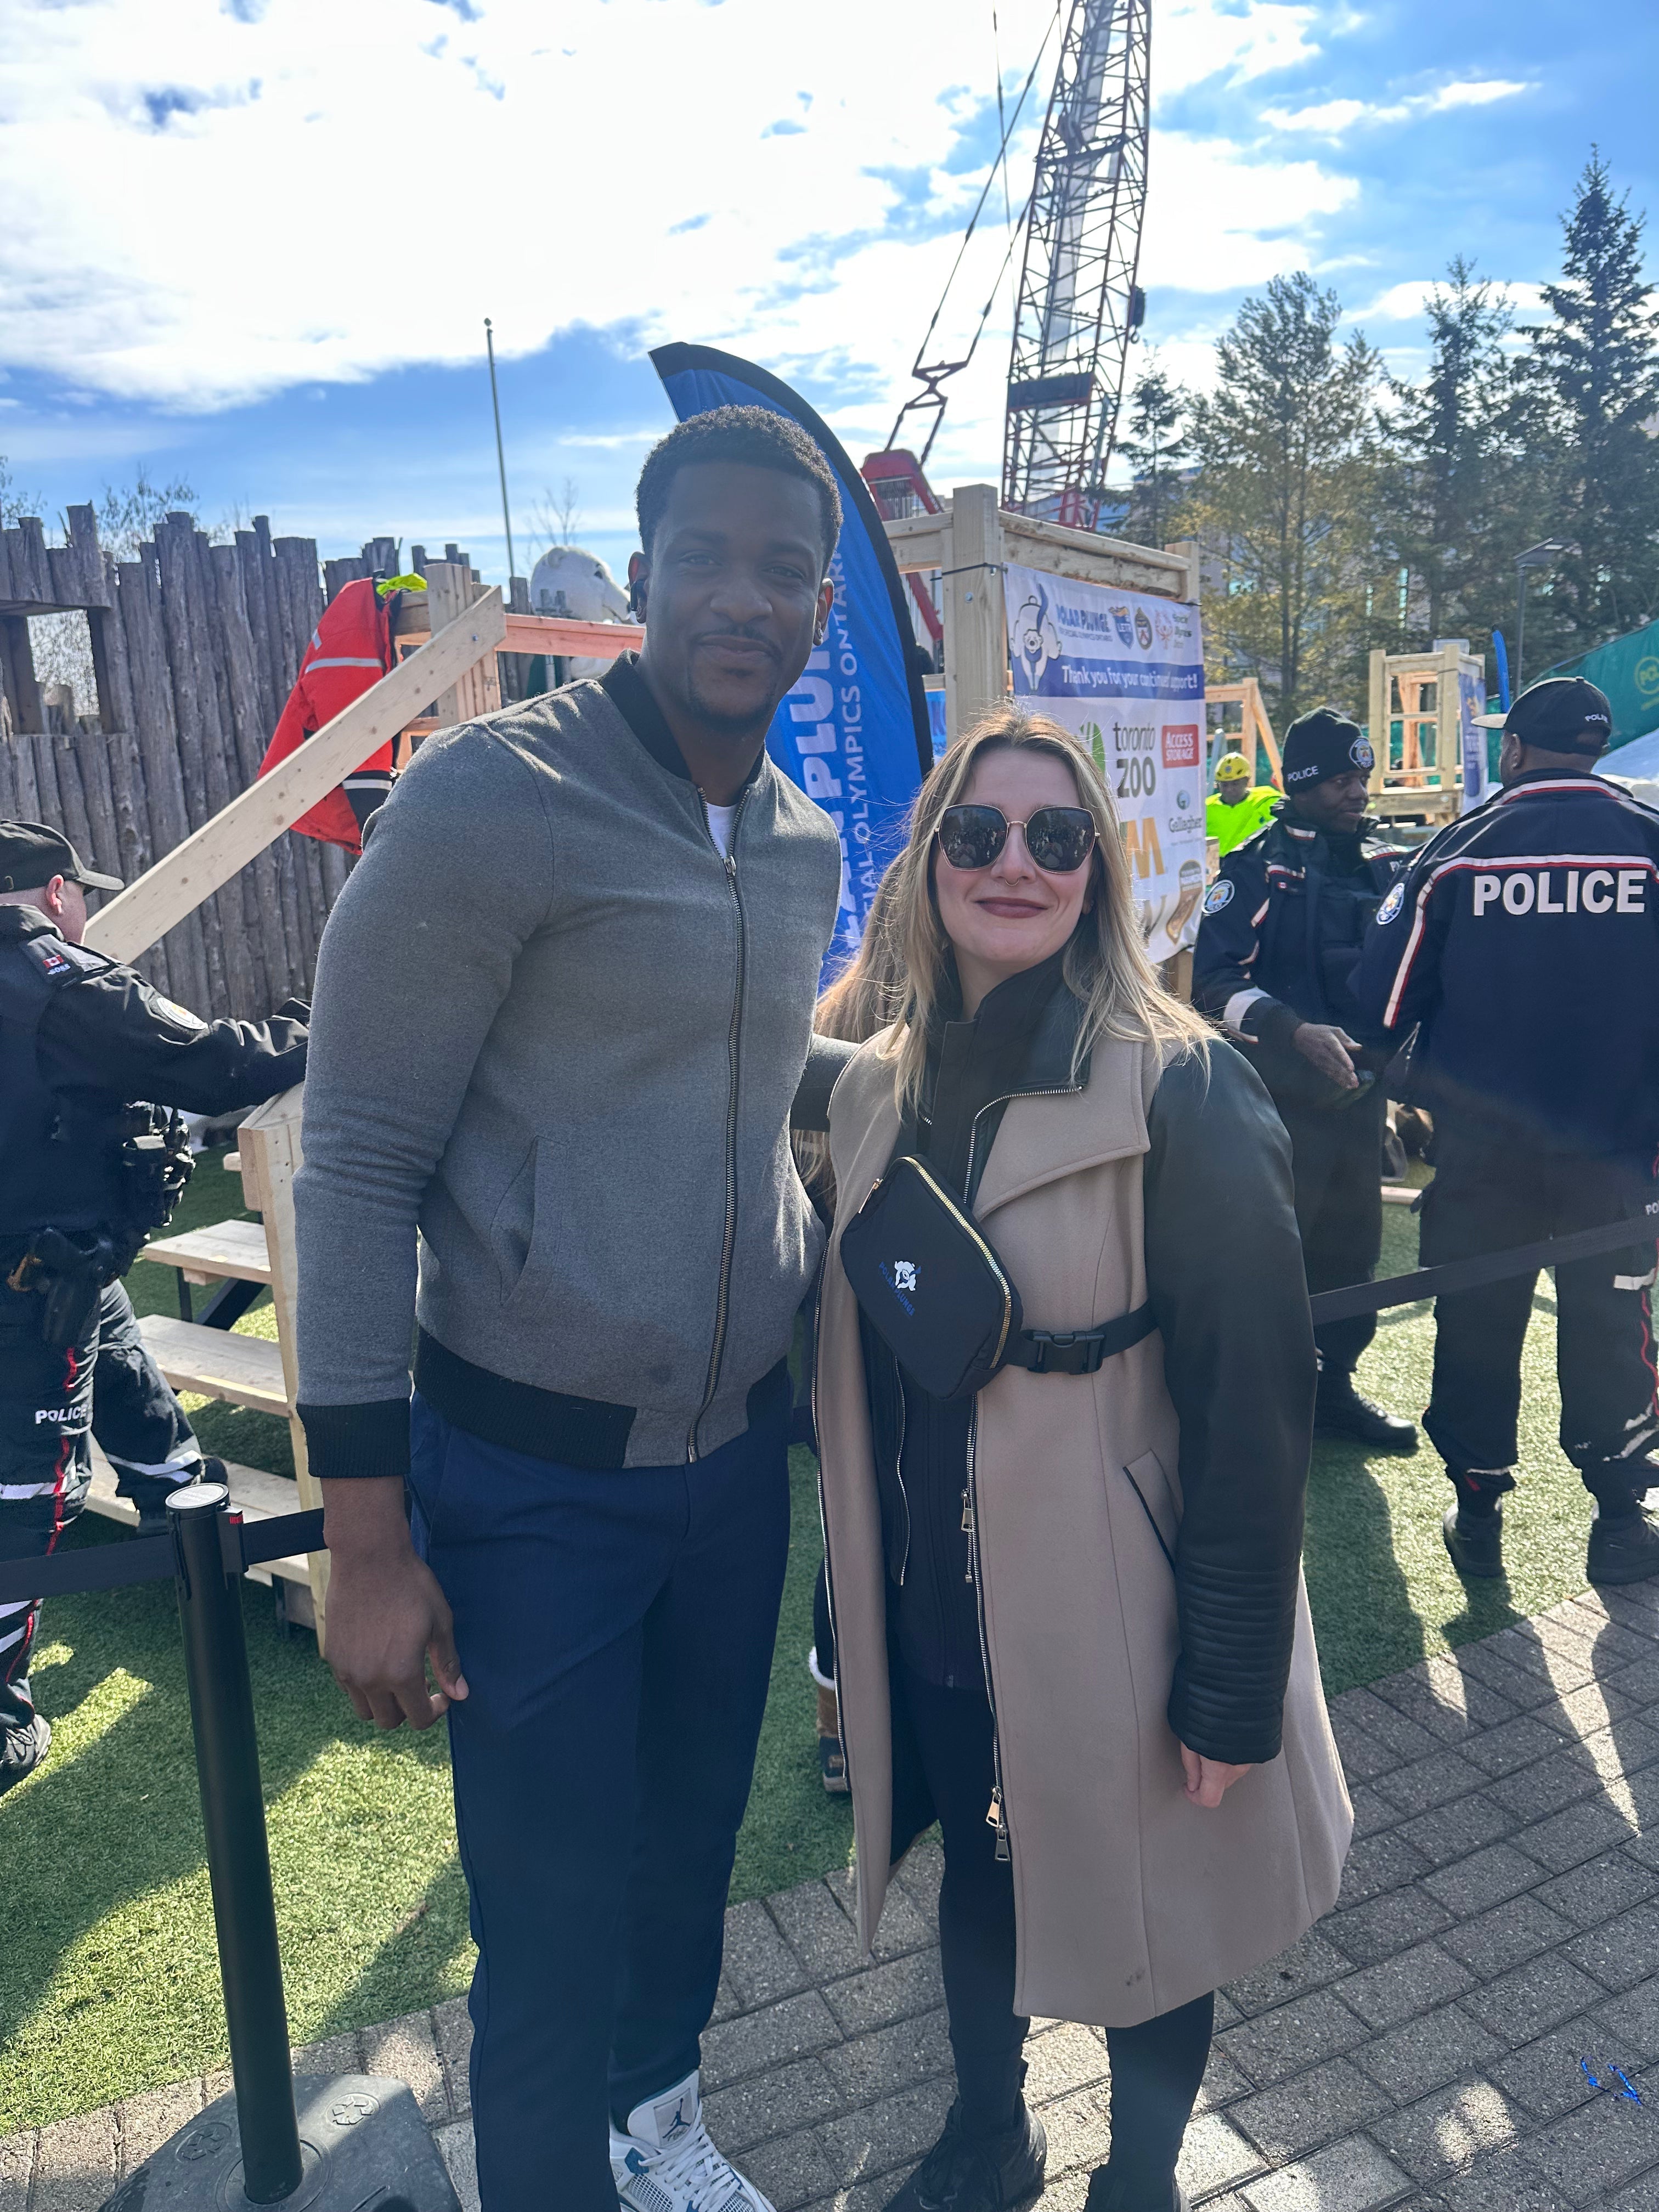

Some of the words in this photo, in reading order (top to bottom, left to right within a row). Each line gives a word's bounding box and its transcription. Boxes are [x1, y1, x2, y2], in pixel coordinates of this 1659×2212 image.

[1061, 664, 1090, 685] Thank
[1090, 670, 1108, 688] you
[1113, 722, 1155, 752] toronto
[840, 686, 871, 844] OLYMPICS
[1287, 765, 1319, 782] POLICE
[1474, 870, 1647, 916] POLICE
[879, 1261, 895, 1290] POLAR
[894, 1288, 915, 1316] PLUNGE
[35, 1404, 88, 1424] POLICE
